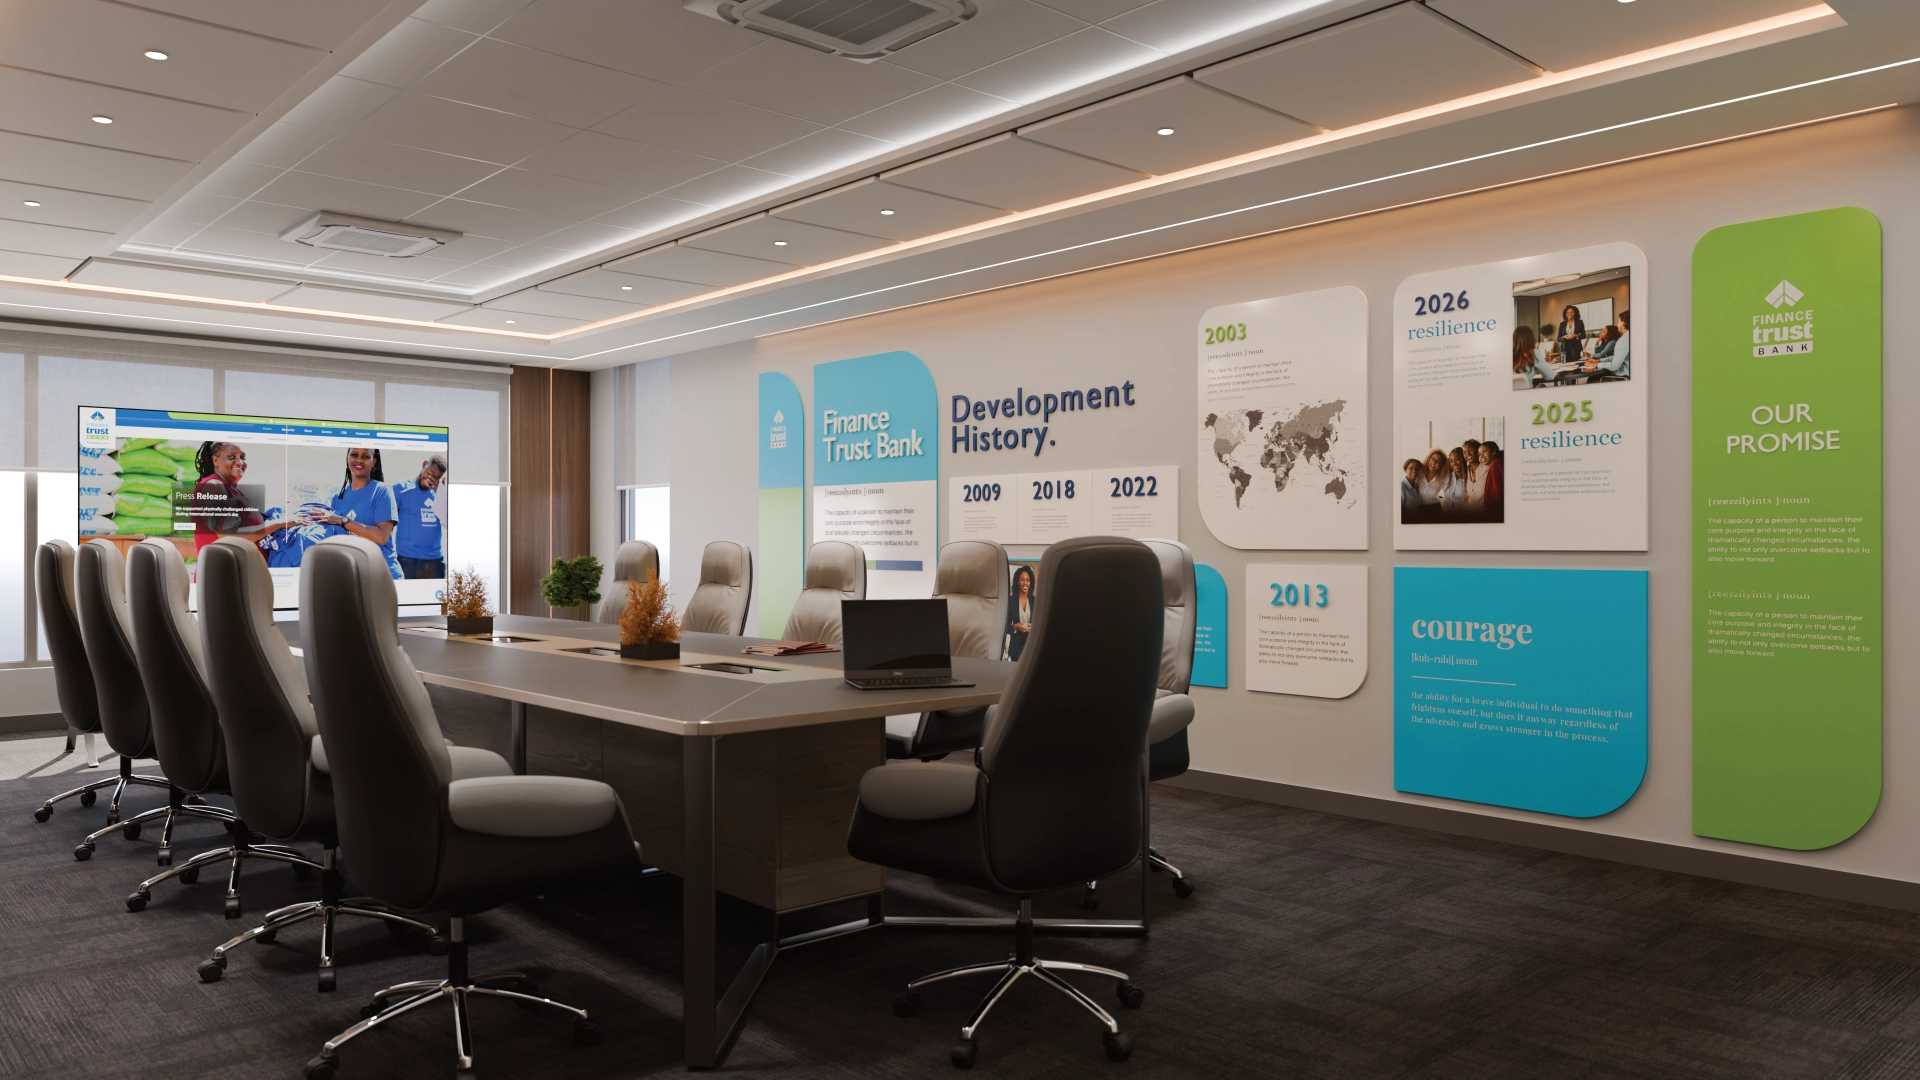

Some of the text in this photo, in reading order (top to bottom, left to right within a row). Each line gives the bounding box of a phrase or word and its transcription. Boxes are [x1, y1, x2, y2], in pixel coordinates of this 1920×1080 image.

[1415, 290, 1469, 315] 2026
[1753, 310, 1813, 325] FINANCE
[1205, 322, 1246, 344] 2003
[1408, 319, 1496, 340] resilience
[1753, 320, 1813, 344] trust
[1758, 344, 1808, 355] BANK
[952, 380, 1135, 423] Development
[1532, 400, 1593, 425] 2025
[824, 410, 889, 435] Finance
[1752, 404, 1813, 425] OUR
[771, 432, 786, 442] trust
[823, 429, 924, 462] Trust Bank
[952, 425, 1056, 456] History.
[1521, 431, 1622, 449] resilience
[1727, 430, 1840, 454] PROMISE
[964, 483, 1001, 502] 2009
[1032, 480, 1075, 500] 2018
[1110, 476, 1158, 497] 2022
[1270, 582, 1328, 608] 2013
[1412, 619, 1532, 650] courage
[1708, 628, 1750, 638] dramatically
[1753, 631, 1784, 639] changed
[1787, 632, 1845, 641] circumstances,
[1773, 622, 1802, 630] integrity
[1708, 638, 1728, 646] ability
[1412, 653, 1478, 666] [kuh-ruhj] noun
[1412, 704, 1446, 714] frightens
[1481, 710, 1493, 718] but
[1496, 711, 1514, 720] does
[1518, 713, 1523, 721] it
[1526, 716, 1557, 726] anyway
[1560, 718, 1606, 729] regardless
[1609, 721, 1618, 730] of
[1426, 693, 1449, 704] ability
[1452, 695, 1463, 703] for
[1472, 696, 1494, 706] brave
[1497, 699, 1538, 710] individual
[1540, 702, 1549, 711] to
[1552, 703, 1562, 712] do
[1565, 706, 1611, 719] something
[1614, 708, 1632, 718] that
[1426, 717, 1460, 729] adversity
[1506, 725, 1541, 737] stronger
[1544, 728, 1552, 736] in
[1555, 729, 1569, 738] the
[1572, 733, 1608, 742] process.
